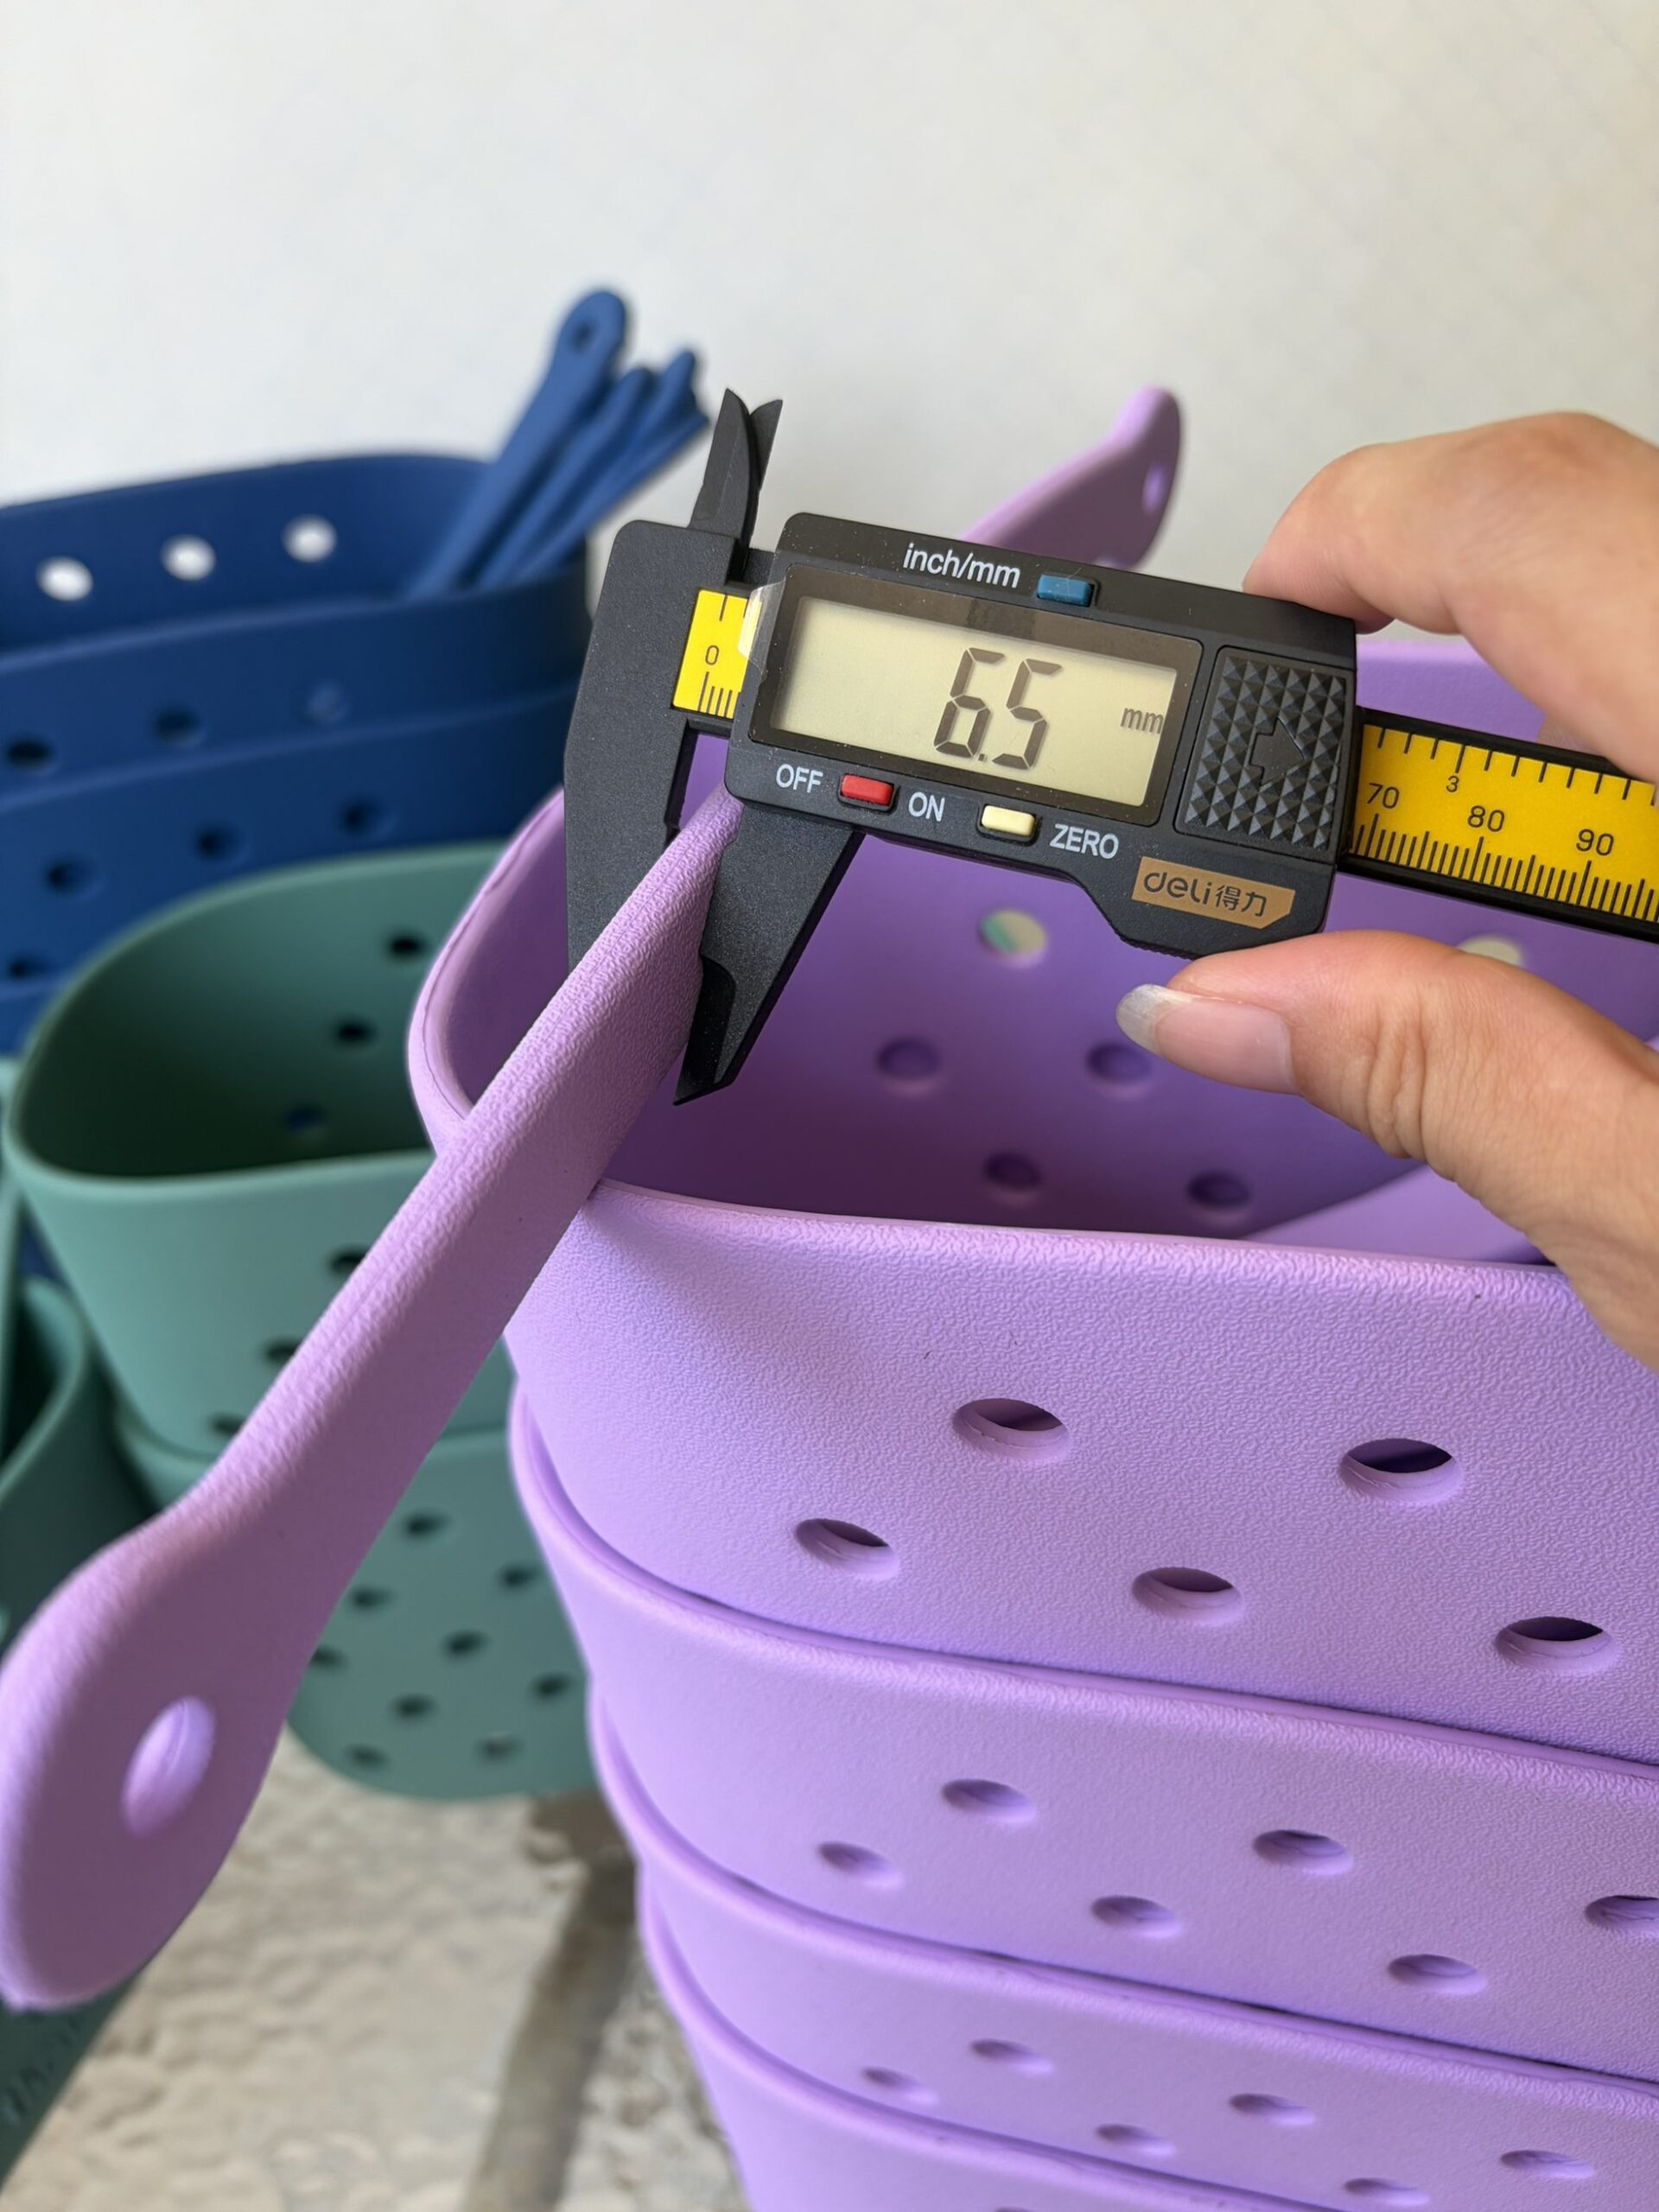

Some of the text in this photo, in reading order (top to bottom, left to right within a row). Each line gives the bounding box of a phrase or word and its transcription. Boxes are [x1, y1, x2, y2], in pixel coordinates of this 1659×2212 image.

[902, 543, 1022, 589] inch/mm
[705, 645, 720, 665] 0
[933, 647, 1164, 770] 6.5 mm
[776, 763, 1120, 860] OFF ON ZERO
[1446, 774, 1460, 794] 3
[1366, 782, 1615, 857] 70 80 90
